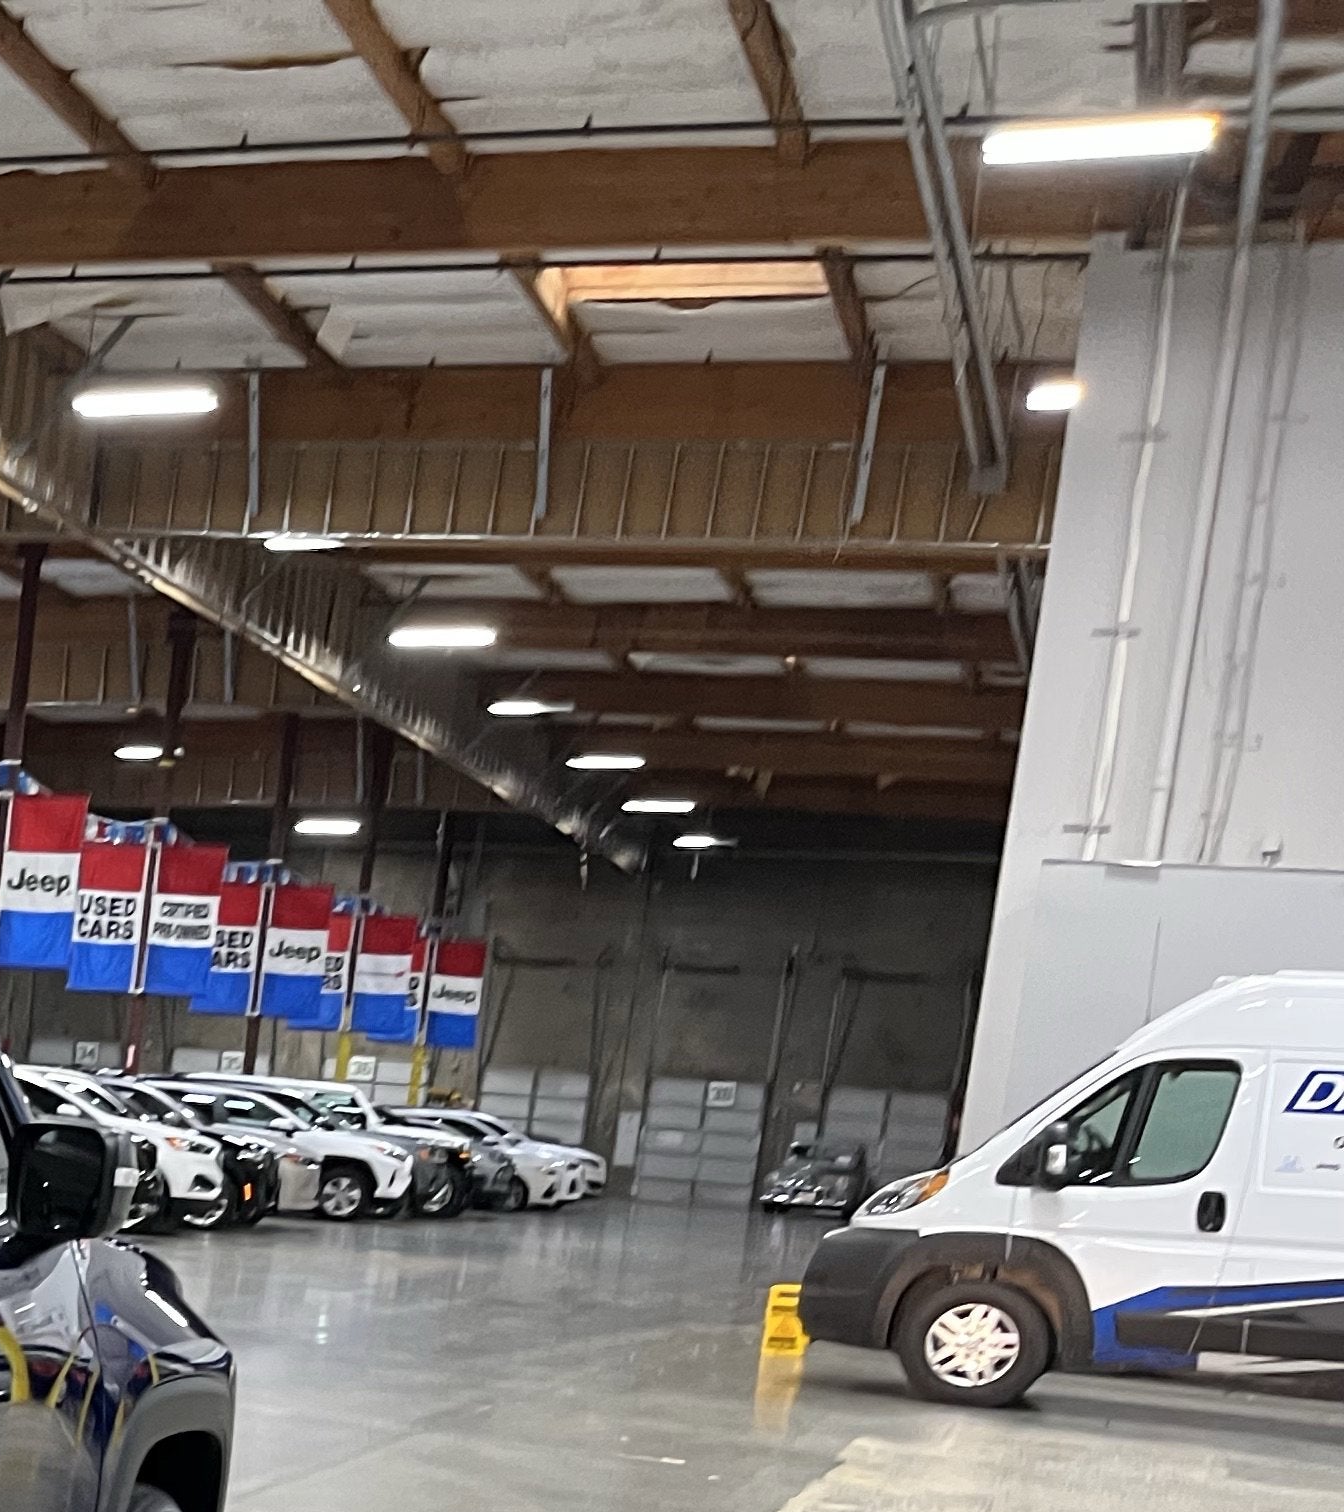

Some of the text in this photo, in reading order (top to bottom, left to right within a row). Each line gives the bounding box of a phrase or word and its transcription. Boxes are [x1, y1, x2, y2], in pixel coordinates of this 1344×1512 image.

[7, 866, 71, 897] Jeep
[78, 893, 137, 917] USED
[76, 917, 135, 940] CARS
[214, 929, 254, 949] SED
[212, 951, 252, 969] ARS
[268, 938, 322, 964] Jeep
[431, 983, 477, 1004] Jeep
